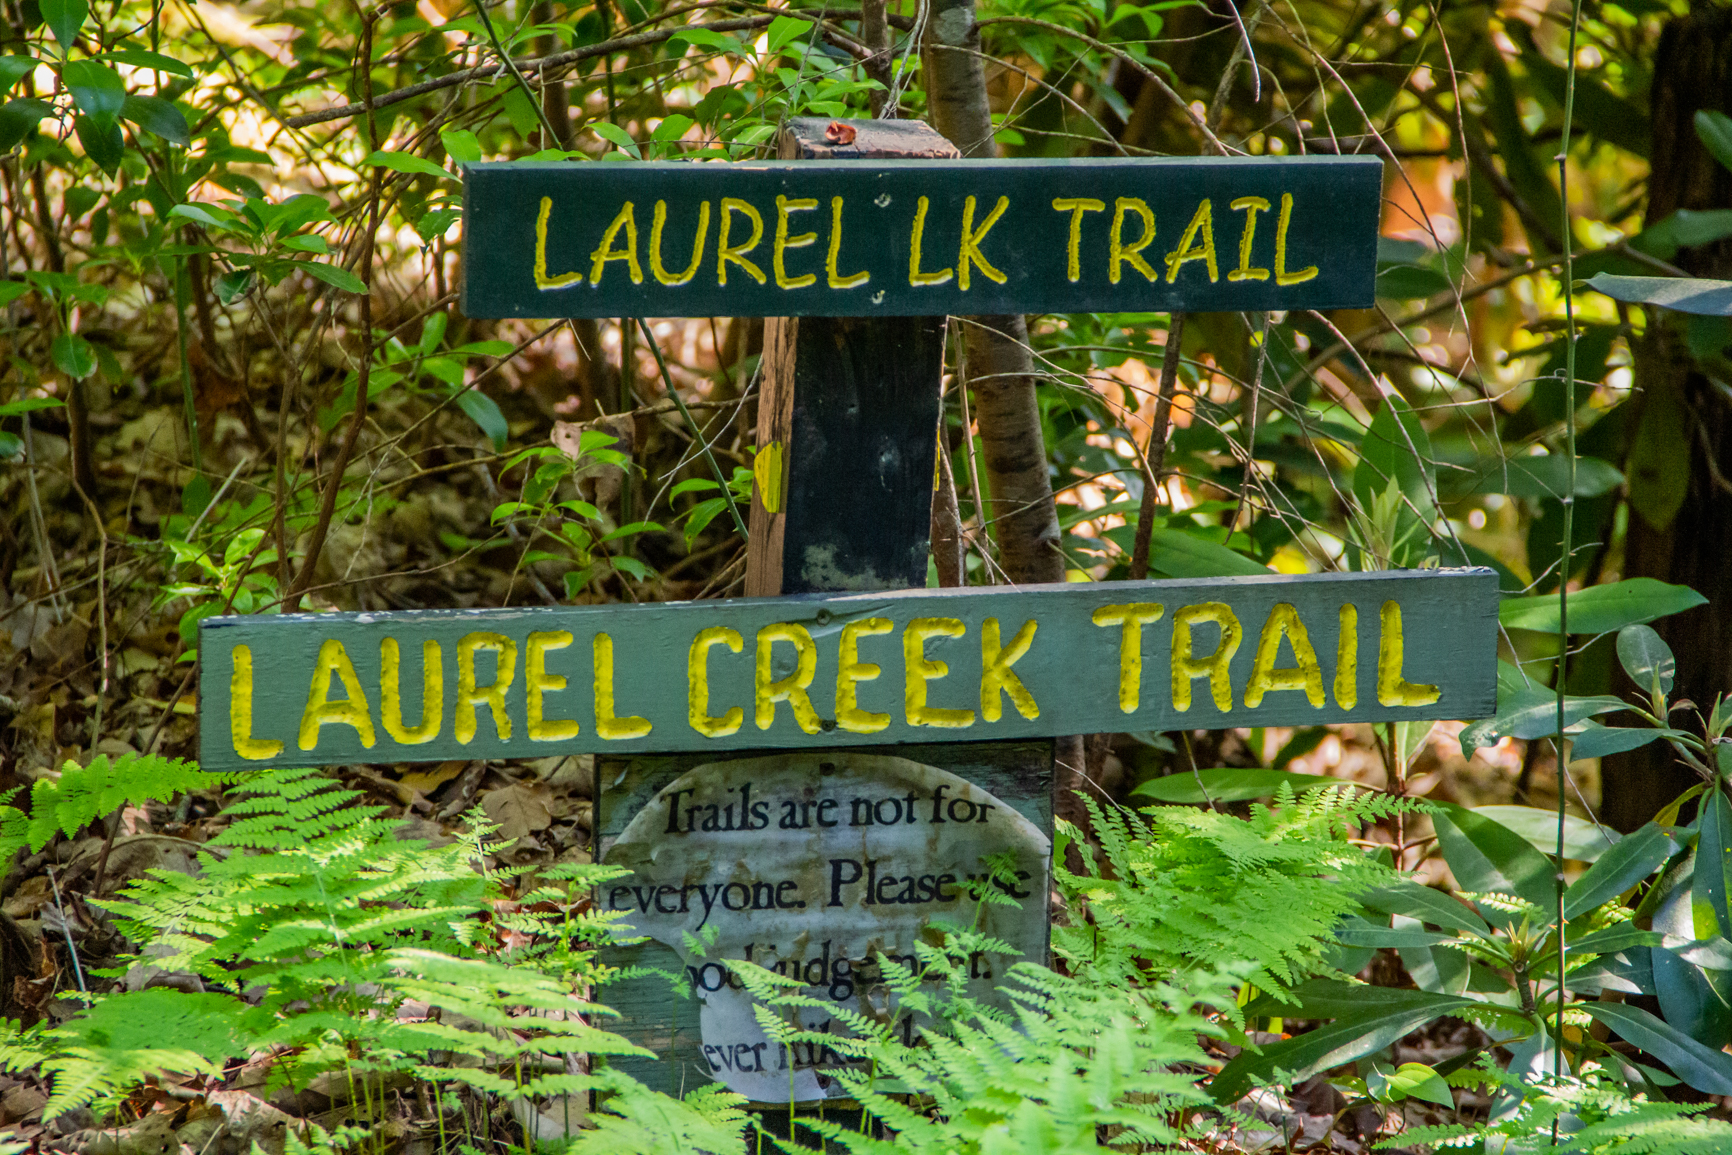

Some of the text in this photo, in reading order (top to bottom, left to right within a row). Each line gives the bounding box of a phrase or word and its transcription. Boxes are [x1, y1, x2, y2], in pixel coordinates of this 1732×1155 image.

[534, 192, 1319, 291] LAUREL LK TRAIL
[230, 600, 1441, 761] LAUREL CREEK TRAIL
[660, 782, 995, 834] Trails are not for
[608, 879, 806, 932] everyone.
[826, 858, 957, 907] Please
